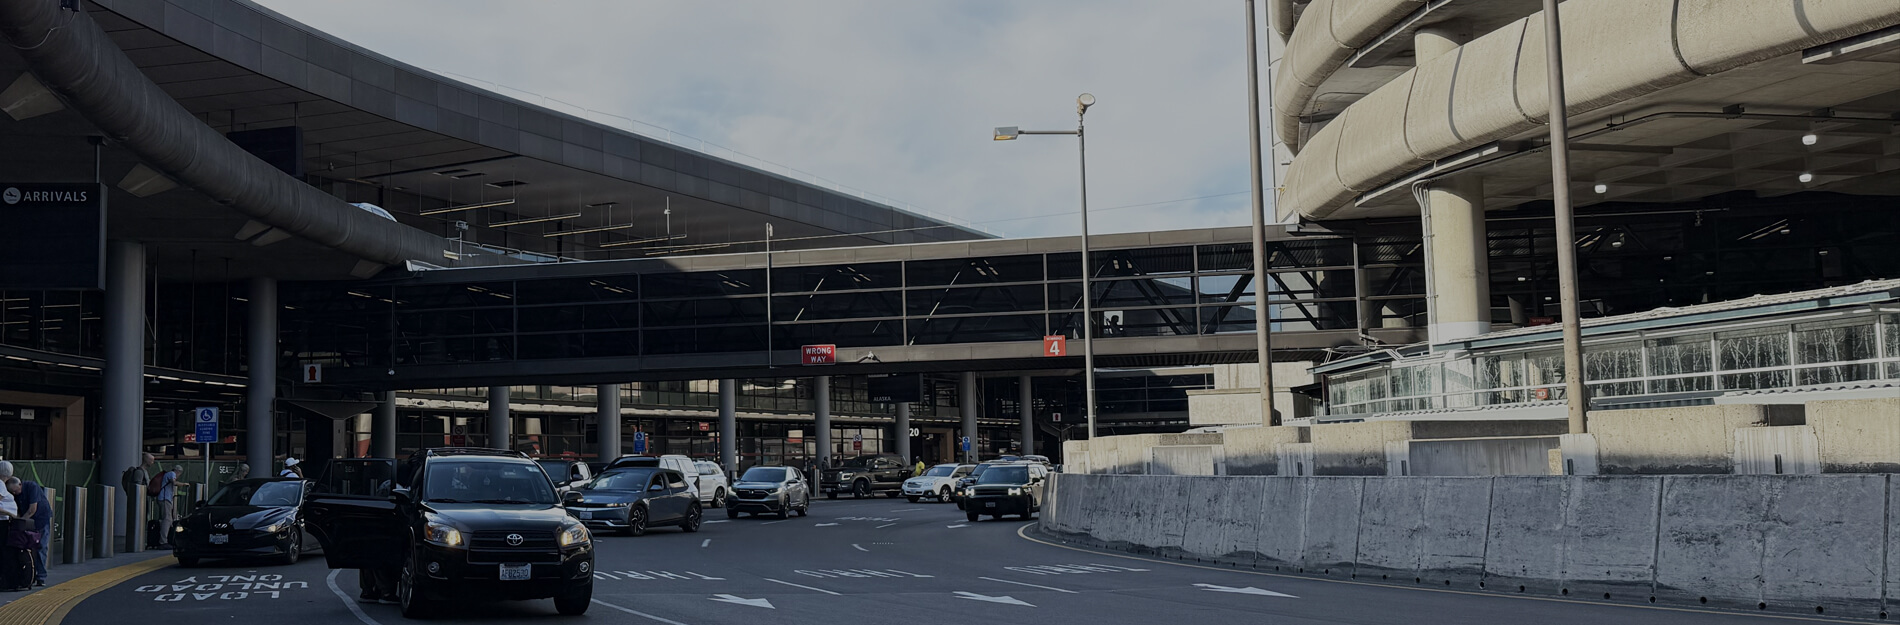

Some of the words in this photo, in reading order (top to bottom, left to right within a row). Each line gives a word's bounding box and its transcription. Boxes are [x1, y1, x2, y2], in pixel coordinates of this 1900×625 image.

[23, 191, 88, 202] ARRIVALS
[805, 347, 832, 355] WRONG
[1049, 340, 1061, 356] 4
[810, 355, 827, 363] WAY
[909, 427, 920, 437] 20
[219, 465, 229, 474] SEA
[175, 574, 283, 584] ONLY
[134, 581, 309, 593] UNLOAD
[153, 591, 280, 602] LOAD
